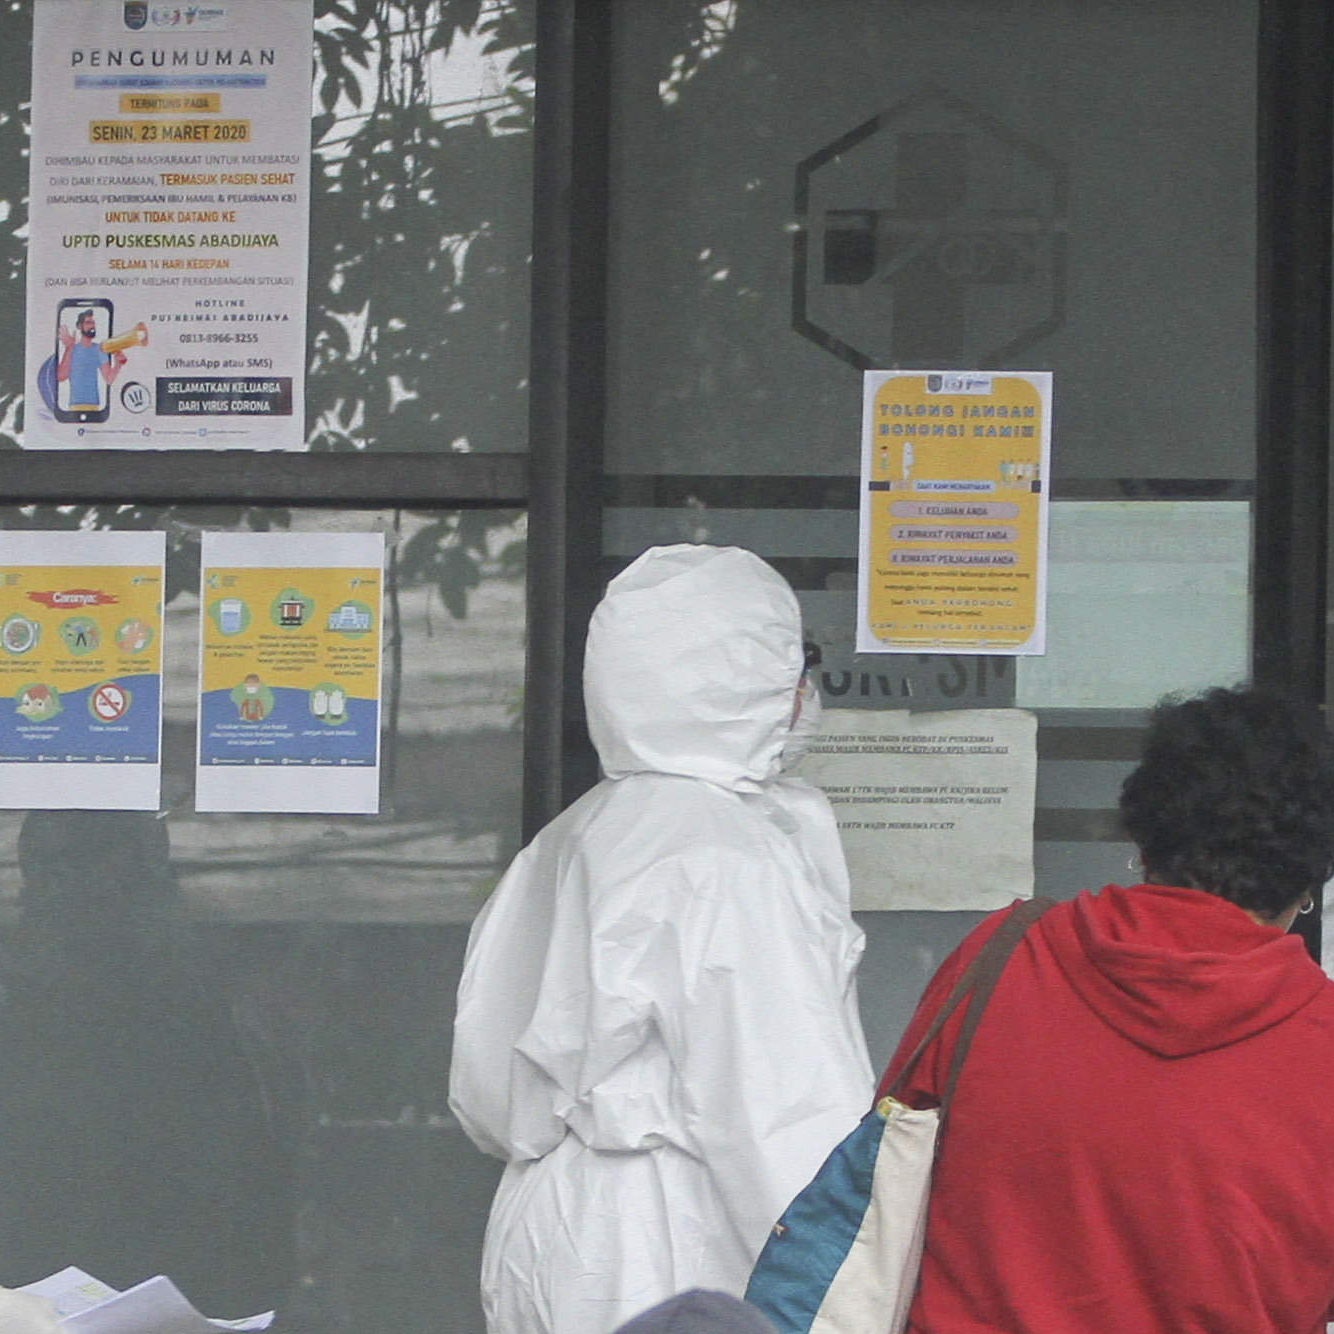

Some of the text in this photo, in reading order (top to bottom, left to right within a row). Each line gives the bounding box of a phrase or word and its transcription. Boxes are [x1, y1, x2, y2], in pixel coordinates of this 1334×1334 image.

[72, 50, 275, 67] PENGUMUMAN
[92, 125, 246, 142] SENIN, 23 MARET 2020
[45, 155, 299, 166] DIHIMBAU KEPADA MASYARAKAT UNTUK MEMBATASI
[160, 174, 216, 185] TERMASUK
[221, 174, 257, 185] PASIEN
[261, 173, 295, 184] SEHAT
[227, 194, 279, 203] PELAYANAN
[106, 212, 235, 223] UNTUK TIDAK DATANG KE
[62, 234, 278, 248] UPTD PUSKESMAS ABADIJAYA
[109, 260, 229, 269] SELAMA 14 HARI KEDEPAN
[180, 334, 258, 343] 0813-8966-3255
[166, 359, 272, 369] (WhatsApp atau SMS)
[168, 383, 281, 393] SELAMATKAN KELUARGA
[178, 401, 270, 411] DARI VIRUS CORONA
[880, 404, 954, 417] TOLONG
